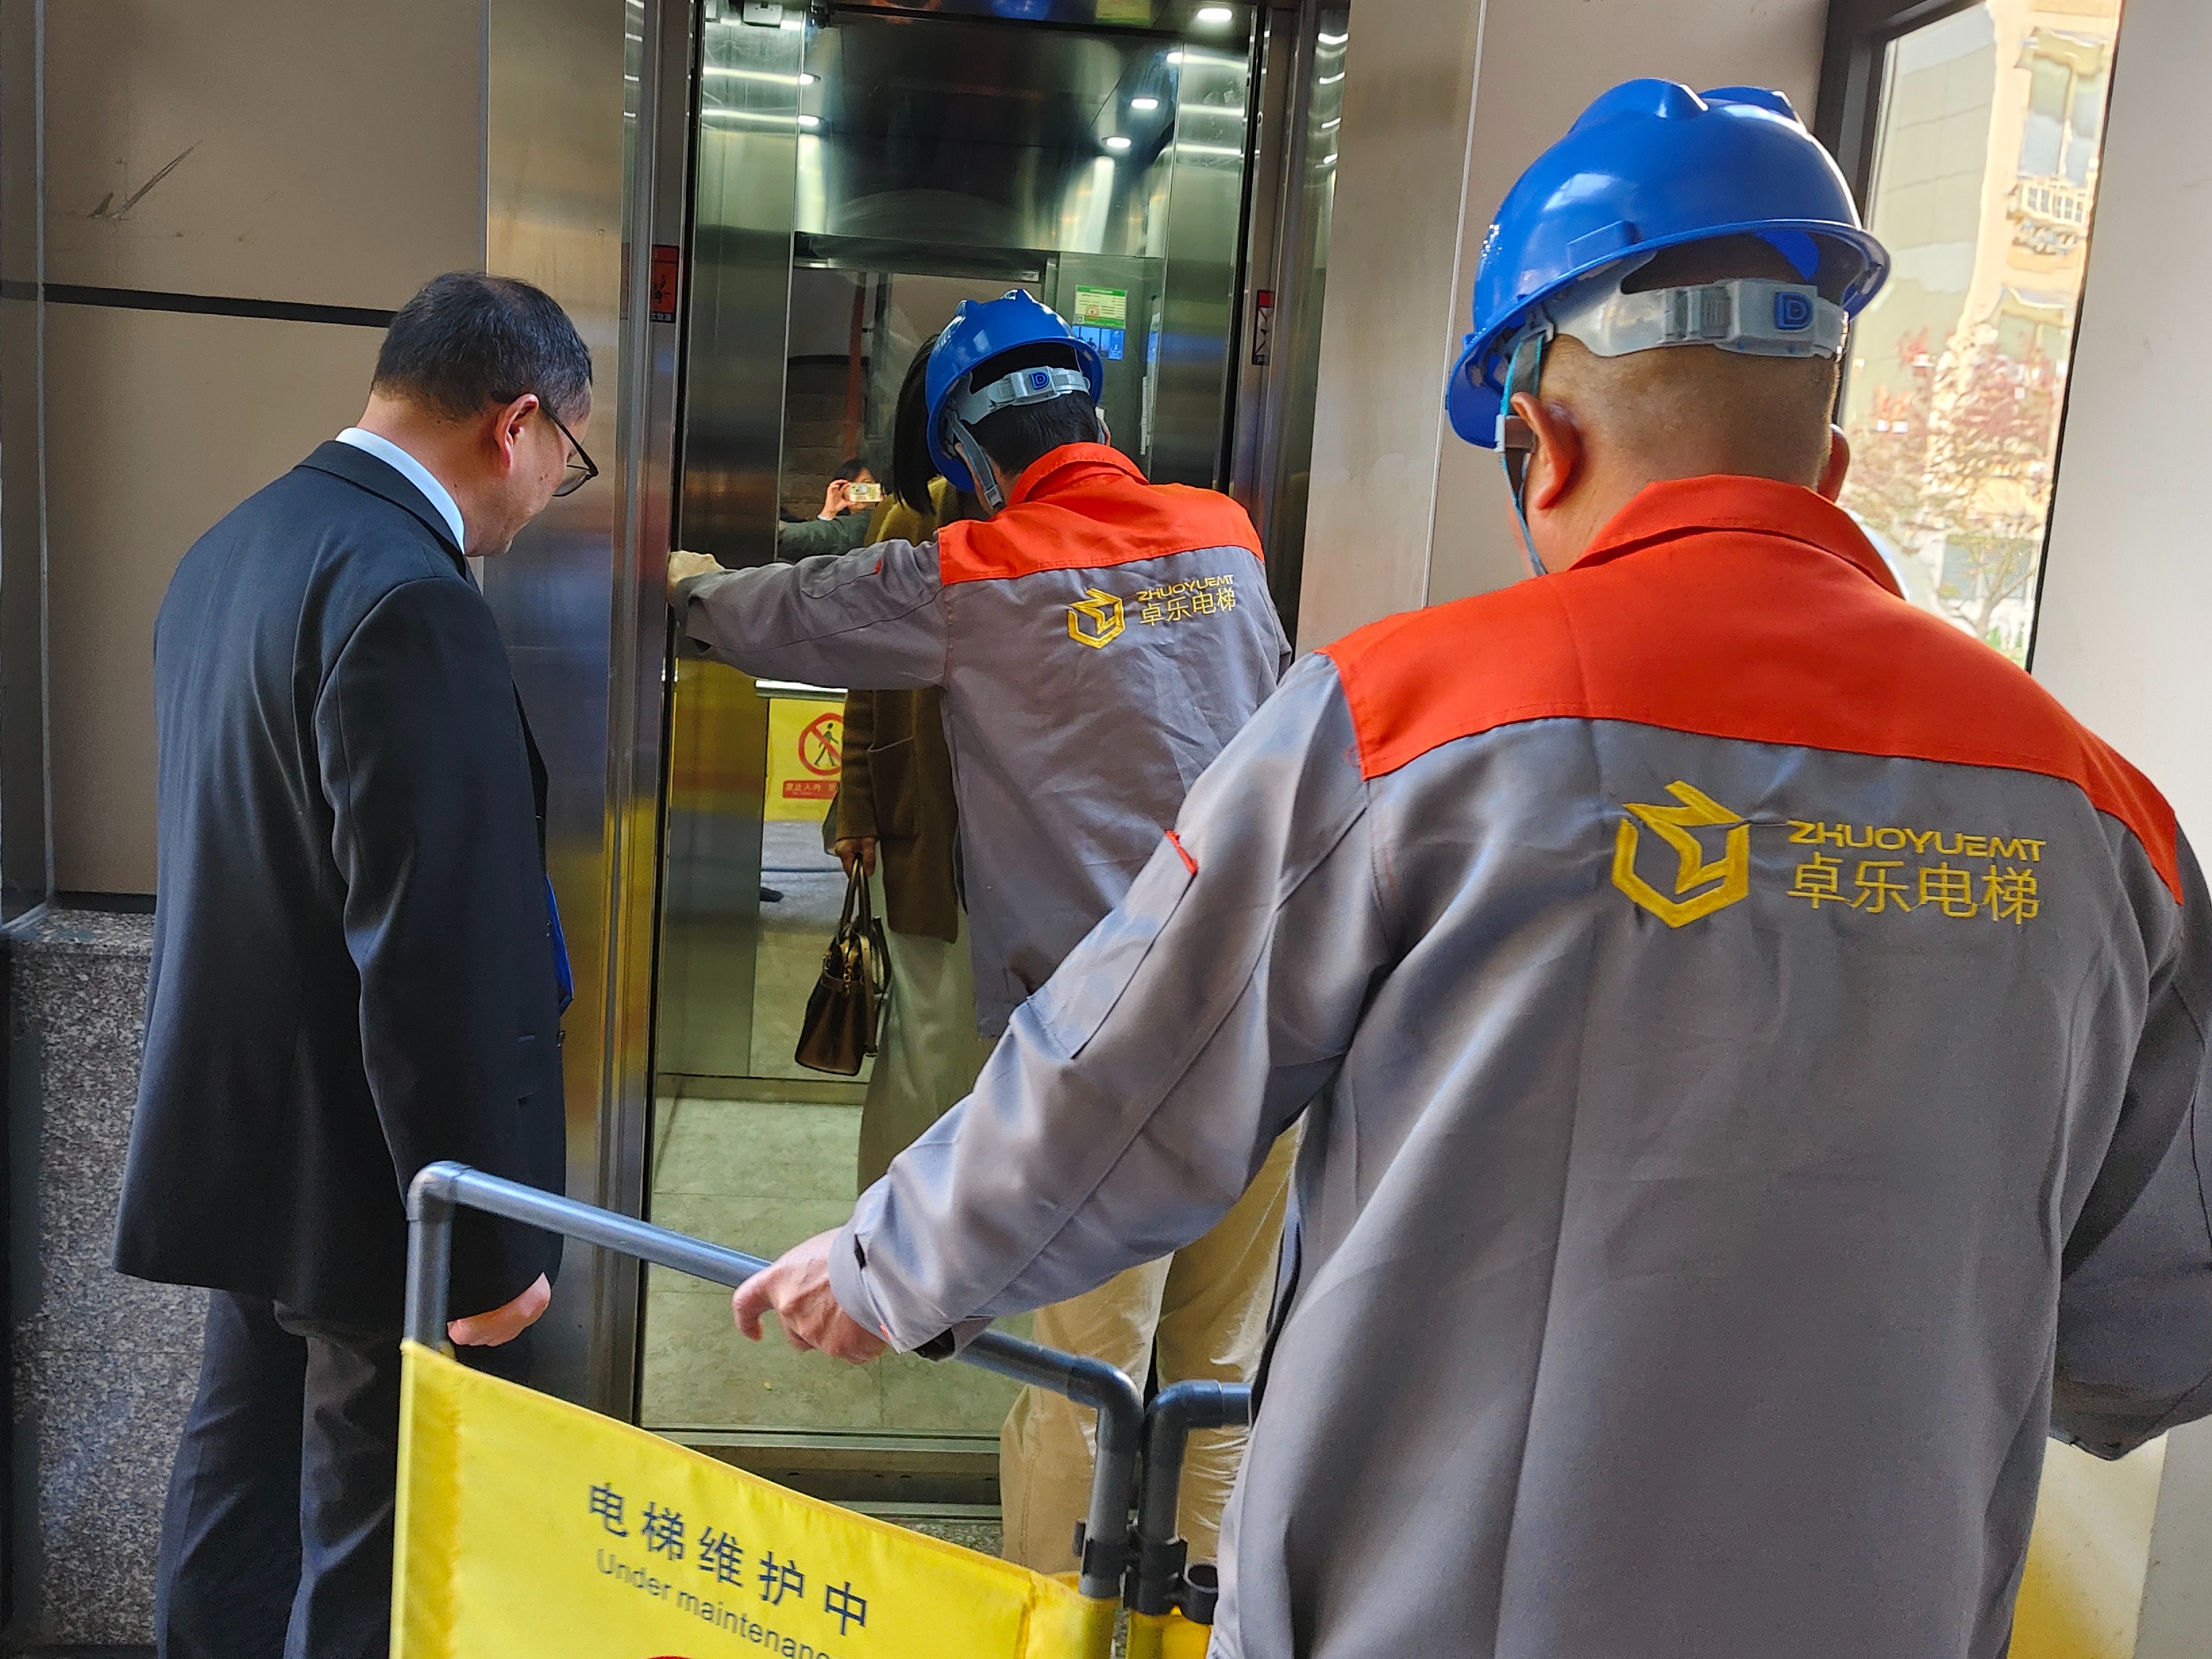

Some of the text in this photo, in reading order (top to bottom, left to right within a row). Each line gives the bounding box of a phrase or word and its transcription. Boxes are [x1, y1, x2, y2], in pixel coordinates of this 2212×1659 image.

[1136, 575, 1234, 602] ZHUOYUEMT
[1139, 587, 1236, 627] 卓乐电梯
[1786, 819, 2048, 863] ZHUOYUEMT
[1786, 851, 2040, 926] 卓乐电梯
[589, 1481, 868, 1637] 电梯维护中
[596, 1548, 673, 1601] Under
